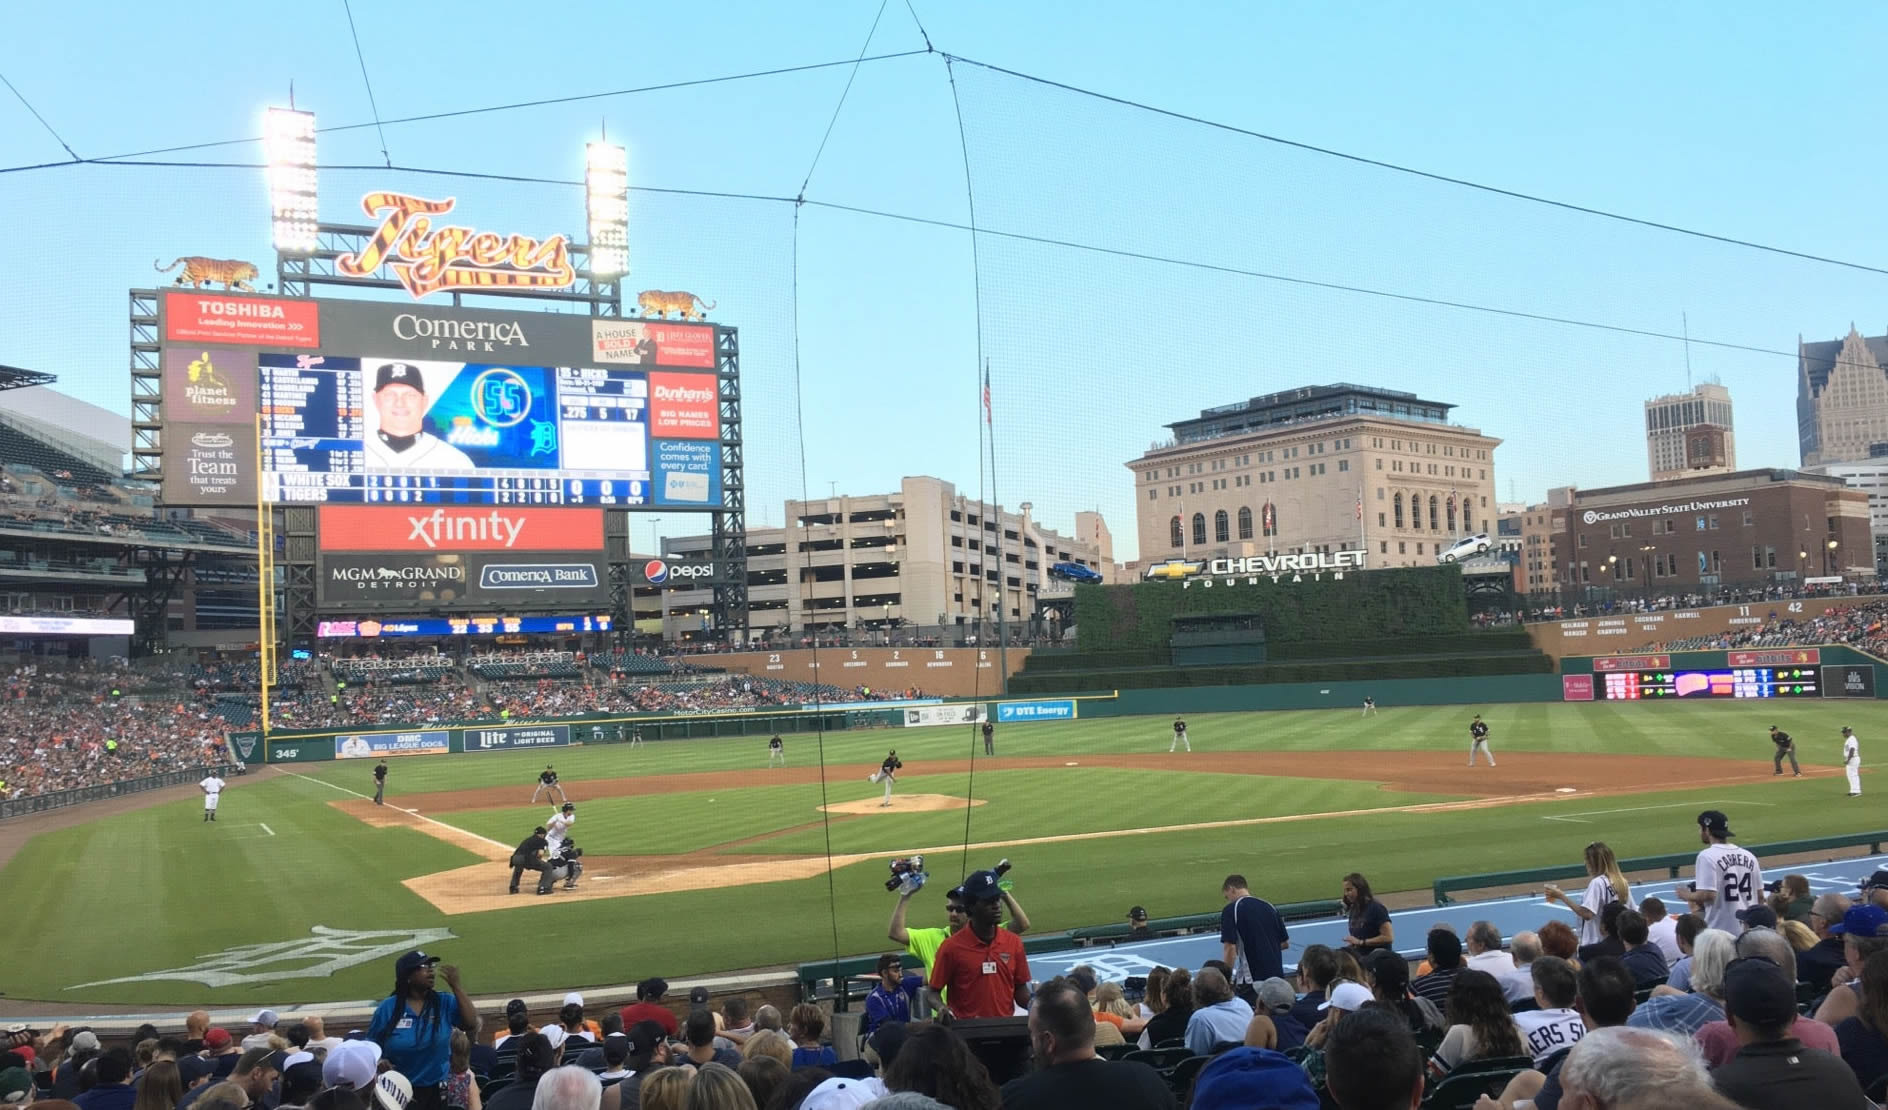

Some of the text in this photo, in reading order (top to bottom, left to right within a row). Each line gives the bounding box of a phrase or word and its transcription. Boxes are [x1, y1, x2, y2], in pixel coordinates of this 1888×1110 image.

[336, 191, 576, 290] Tigers
[198, 301, 285, 318] TOSHIBA
[198, 318, 286, 330] Leading Innovation
[596, 328, 637, 339] A HOUSE
[432, 338, 495, 352] PARK
[604, 340, 631, 350] SOLD
[606, 350, 634, 360] NAME
[185, 386, 228, 399] planet
[655, 385, 714, 400] Dunham's
[191, 394, 237, 406] fitness
[563, 406, 587, 419] .275
[625, 408, 639, 421] 17
[660, 410, 677, 418] BIG
[658, 418, 678, 426] LOW
[660, 442, 711, 453] Confidence
[192, 448, 233, 459] Trust the
[660, 453, 712, 463] comes with
[187, 457, 239, 475] Team
[660, 462, 686, 472] every
[190, 475, 237, 485] that treats
[282, 473, 325, 487] WHITE
[325, 473, 351, 487] SOX
[414, 476, 422, 488] 1
[429, 476, 437, 488] 1
[200, 485, 227, 495] yours
[571, 479, 642, 497] 0 0 0
[283, 487, 328, 501] TIGERS
[414, 490, 423, 502] 2
[501, 491, 510, 503] 2
[517, 491, 526, 503] 2
[1596, 498, 1750, 521] GRAND VALLEY STATE UNIVERSITY
[408, 508, 527, 548] xfinity
[1211, 549, 1369, 575] CHEVROLET
[332, 566, 462, 581] MGM GRAND
[555, 568, 589, 582] Bank
[670, 562, 714, 580] pepsi
[357, 581, 438, 589] DETROIT
[1183, 571, 1344, 589] FOUNTAIN
[1739, 606, 1750, 617] 11
[1788, 602, 1803, 613] 42
[452, 624, 468, 634] 22
[477, 623, 493, 634] 33
[769, 654, 781, 663] 23
[852, 650, 987, 660] 5 2 16 6
[1844, 682, 1865, 690] VISION
[673, 706, 755, 717] MotorCityCasino.com
[1016, 706, 1069, 717] DTE Energy
[397, 734, 422, 743] DMC
[480, 731, 507, 748] Lite
[521, 730, 555, 738] ORIGINAL
[373, 743, 387, 751] BIG
[388, 741, 420, 750] LEAGUE
[514, 736, 556, 745] LIGHT BEER
[1716, 853, 1755, 872] CABRERA
[1723, 872, 1753, 902] 24
[1528, 1023, 1565, 1058] ERS
